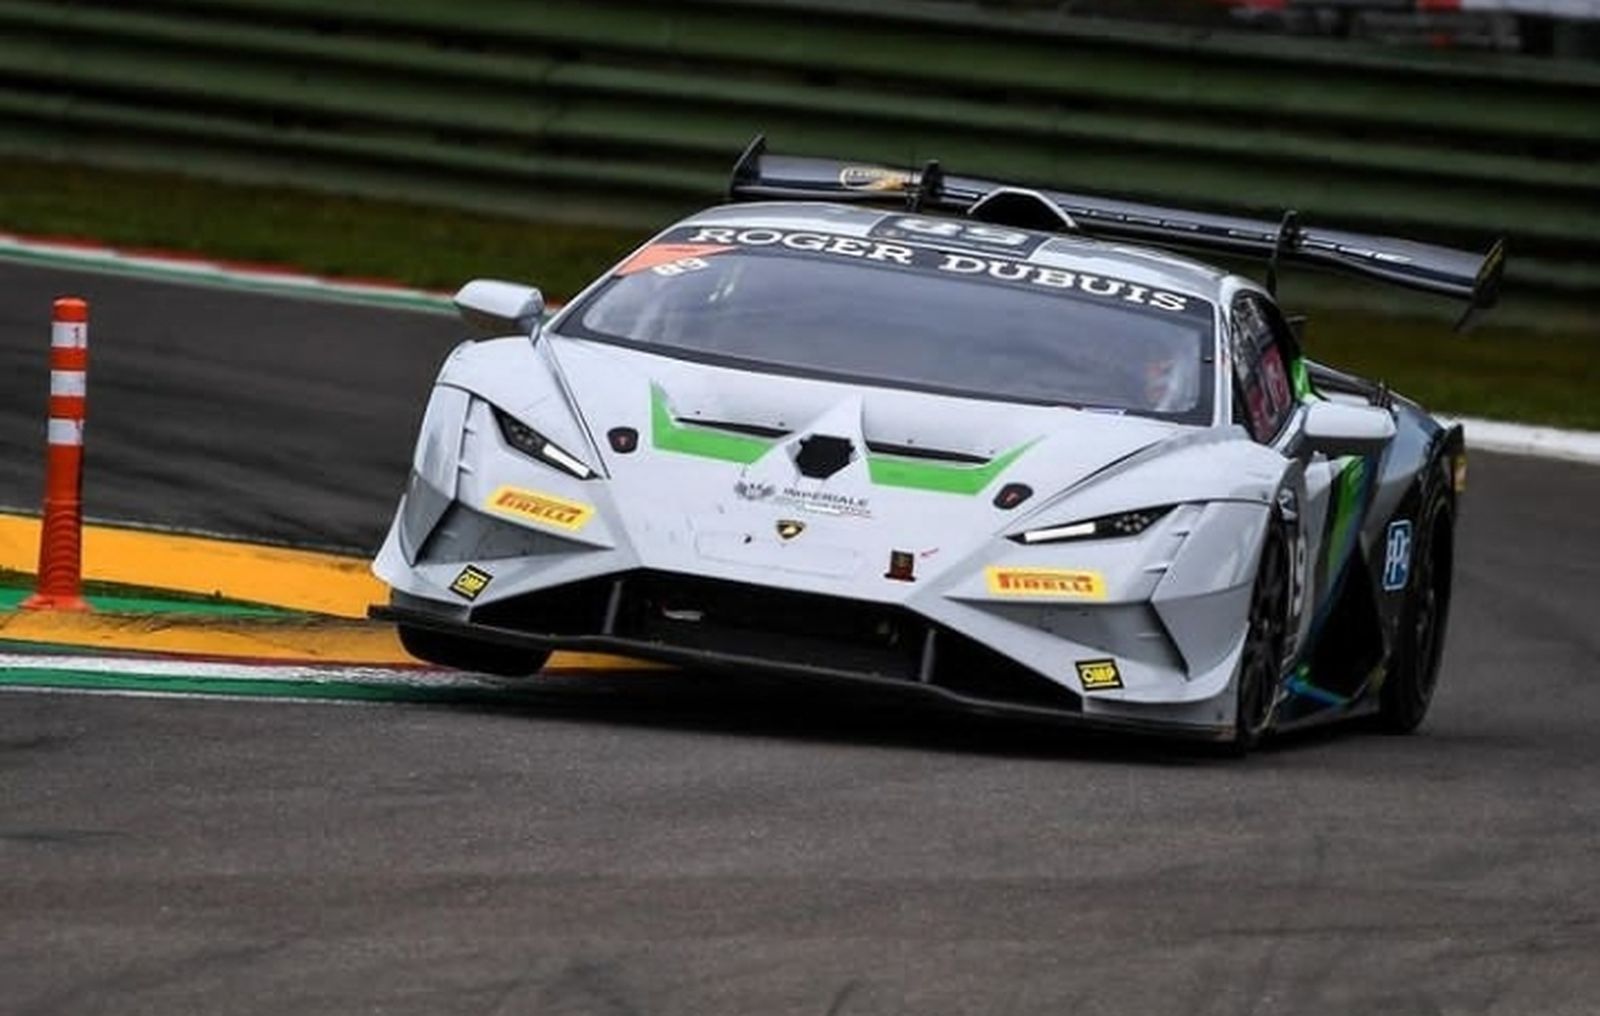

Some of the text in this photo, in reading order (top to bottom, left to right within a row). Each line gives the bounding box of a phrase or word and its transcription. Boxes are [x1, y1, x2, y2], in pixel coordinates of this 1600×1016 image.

[688, 228, 914, 264] ROGER
[937, 254, 1188, 312] DUBUIS
[496, 491, 583, 523] PIRELLI
[998, 572, 1093, 592] PIRELLI
